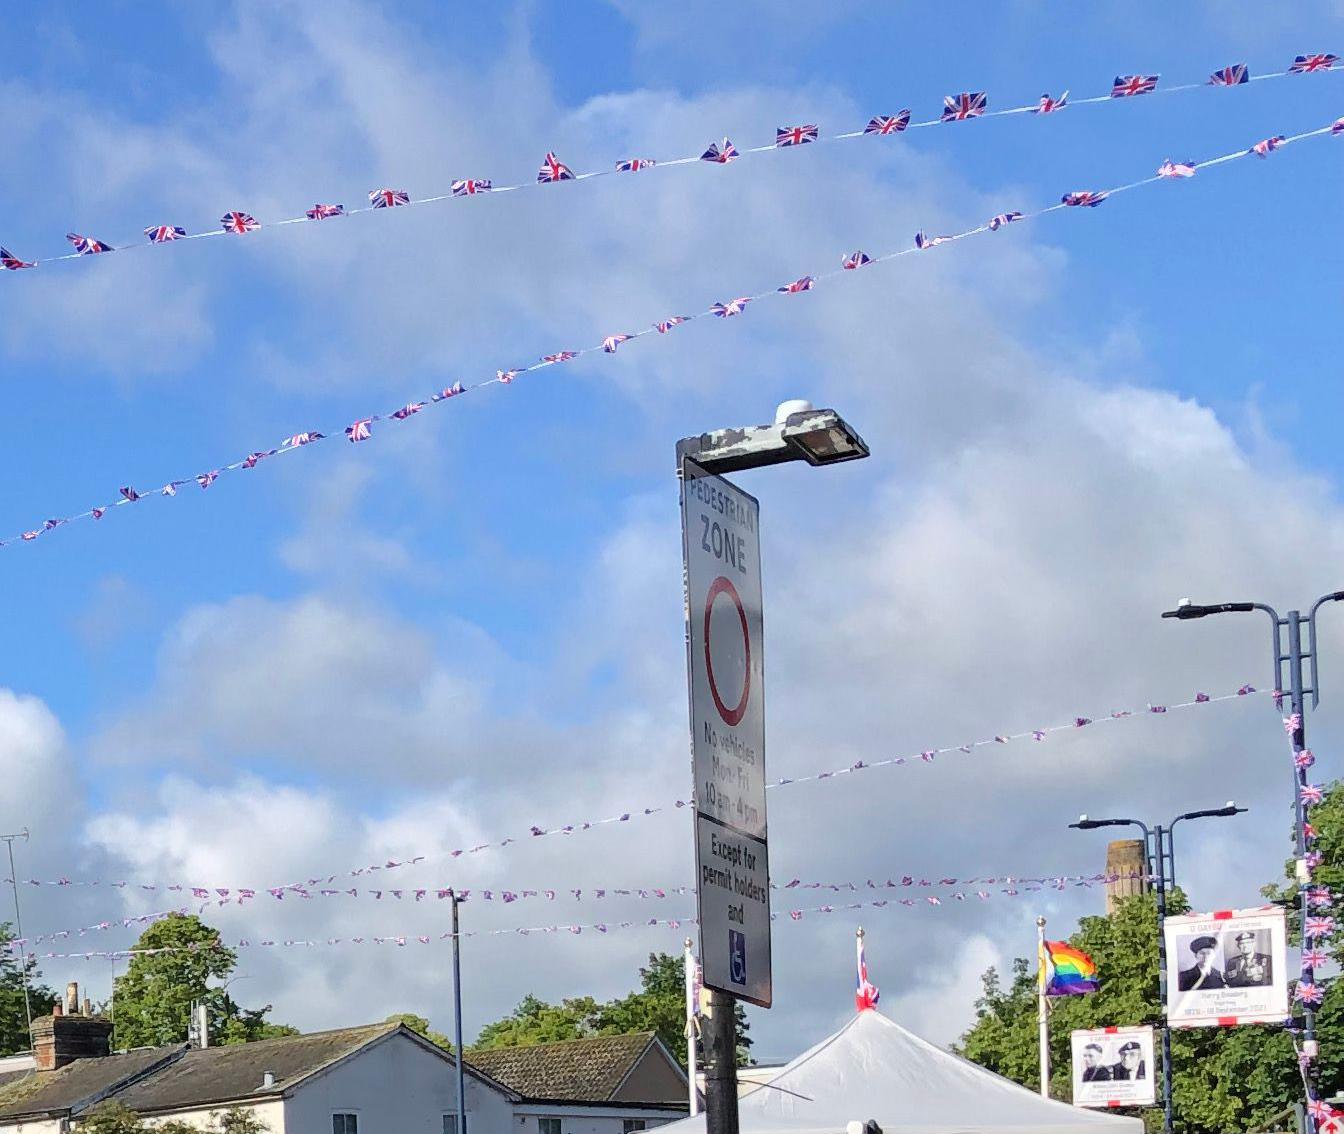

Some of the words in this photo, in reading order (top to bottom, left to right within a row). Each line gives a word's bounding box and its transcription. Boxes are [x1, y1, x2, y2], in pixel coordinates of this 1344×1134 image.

[691, 478, 753, 533] PEDESTRIAN
[701, 514, 746, 574] ZONE
[705, 721, 717, 748] No
[720, 733, 755, 765] vehicles
[712, 833, 741, 867] Except
[744, 846, 756, 871] for
[703, 865, 732, 891] permit
[735, 872, 766, 904] holders
[728, 904, 744, 924] and
